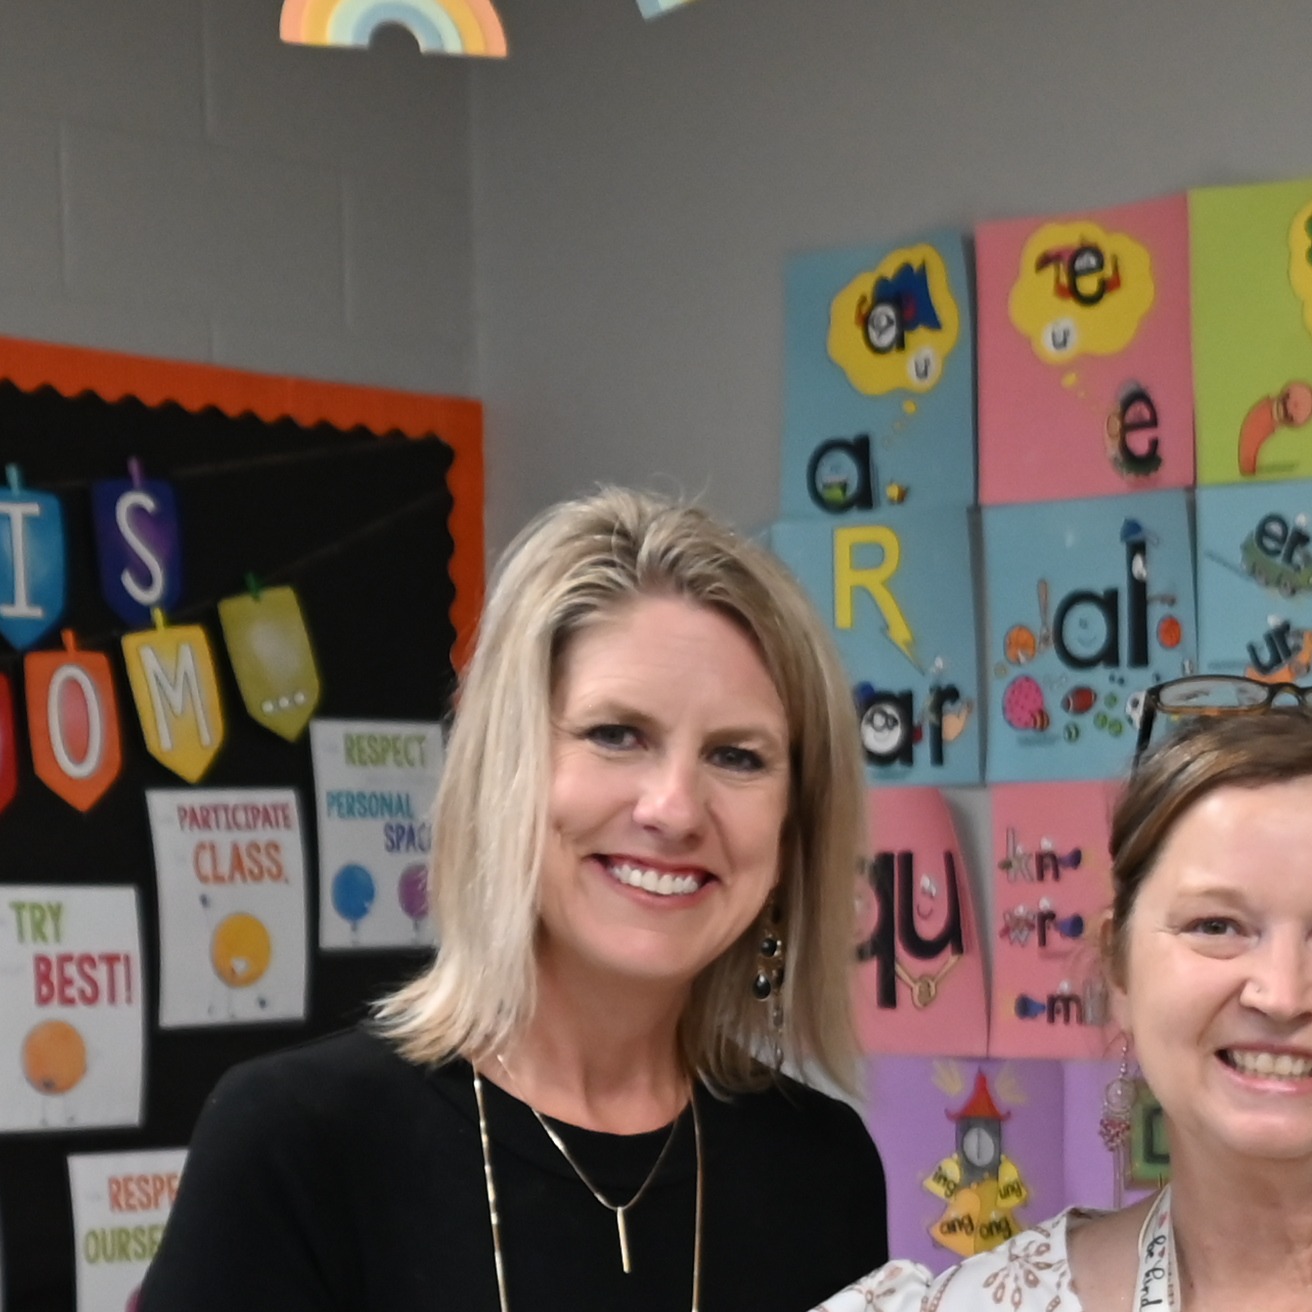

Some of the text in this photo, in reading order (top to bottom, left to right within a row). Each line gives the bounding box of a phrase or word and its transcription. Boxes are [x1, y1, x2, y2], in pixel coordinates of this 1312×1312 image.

[1070, 247, 1108, 307] e
[1119, 388, 1160, 467] e
[807, 435, 874, 515] a
[1254, 513, 1310, 564] er
[833, 525, 925, 676] R
[1053, 539, 1149, 669] al
[344, 734, 426, 768] RESPECT
[177, 804, 292, 831] PARTICIPATE
[326, 791, 414, 819] PERSONAL
[384, 822, 432, 853] SPAC
[10, 902, 63, 943] TRY
[34, 953, 133, 1006] BEST!
[108, 1173, 181, 1212] RESPE
